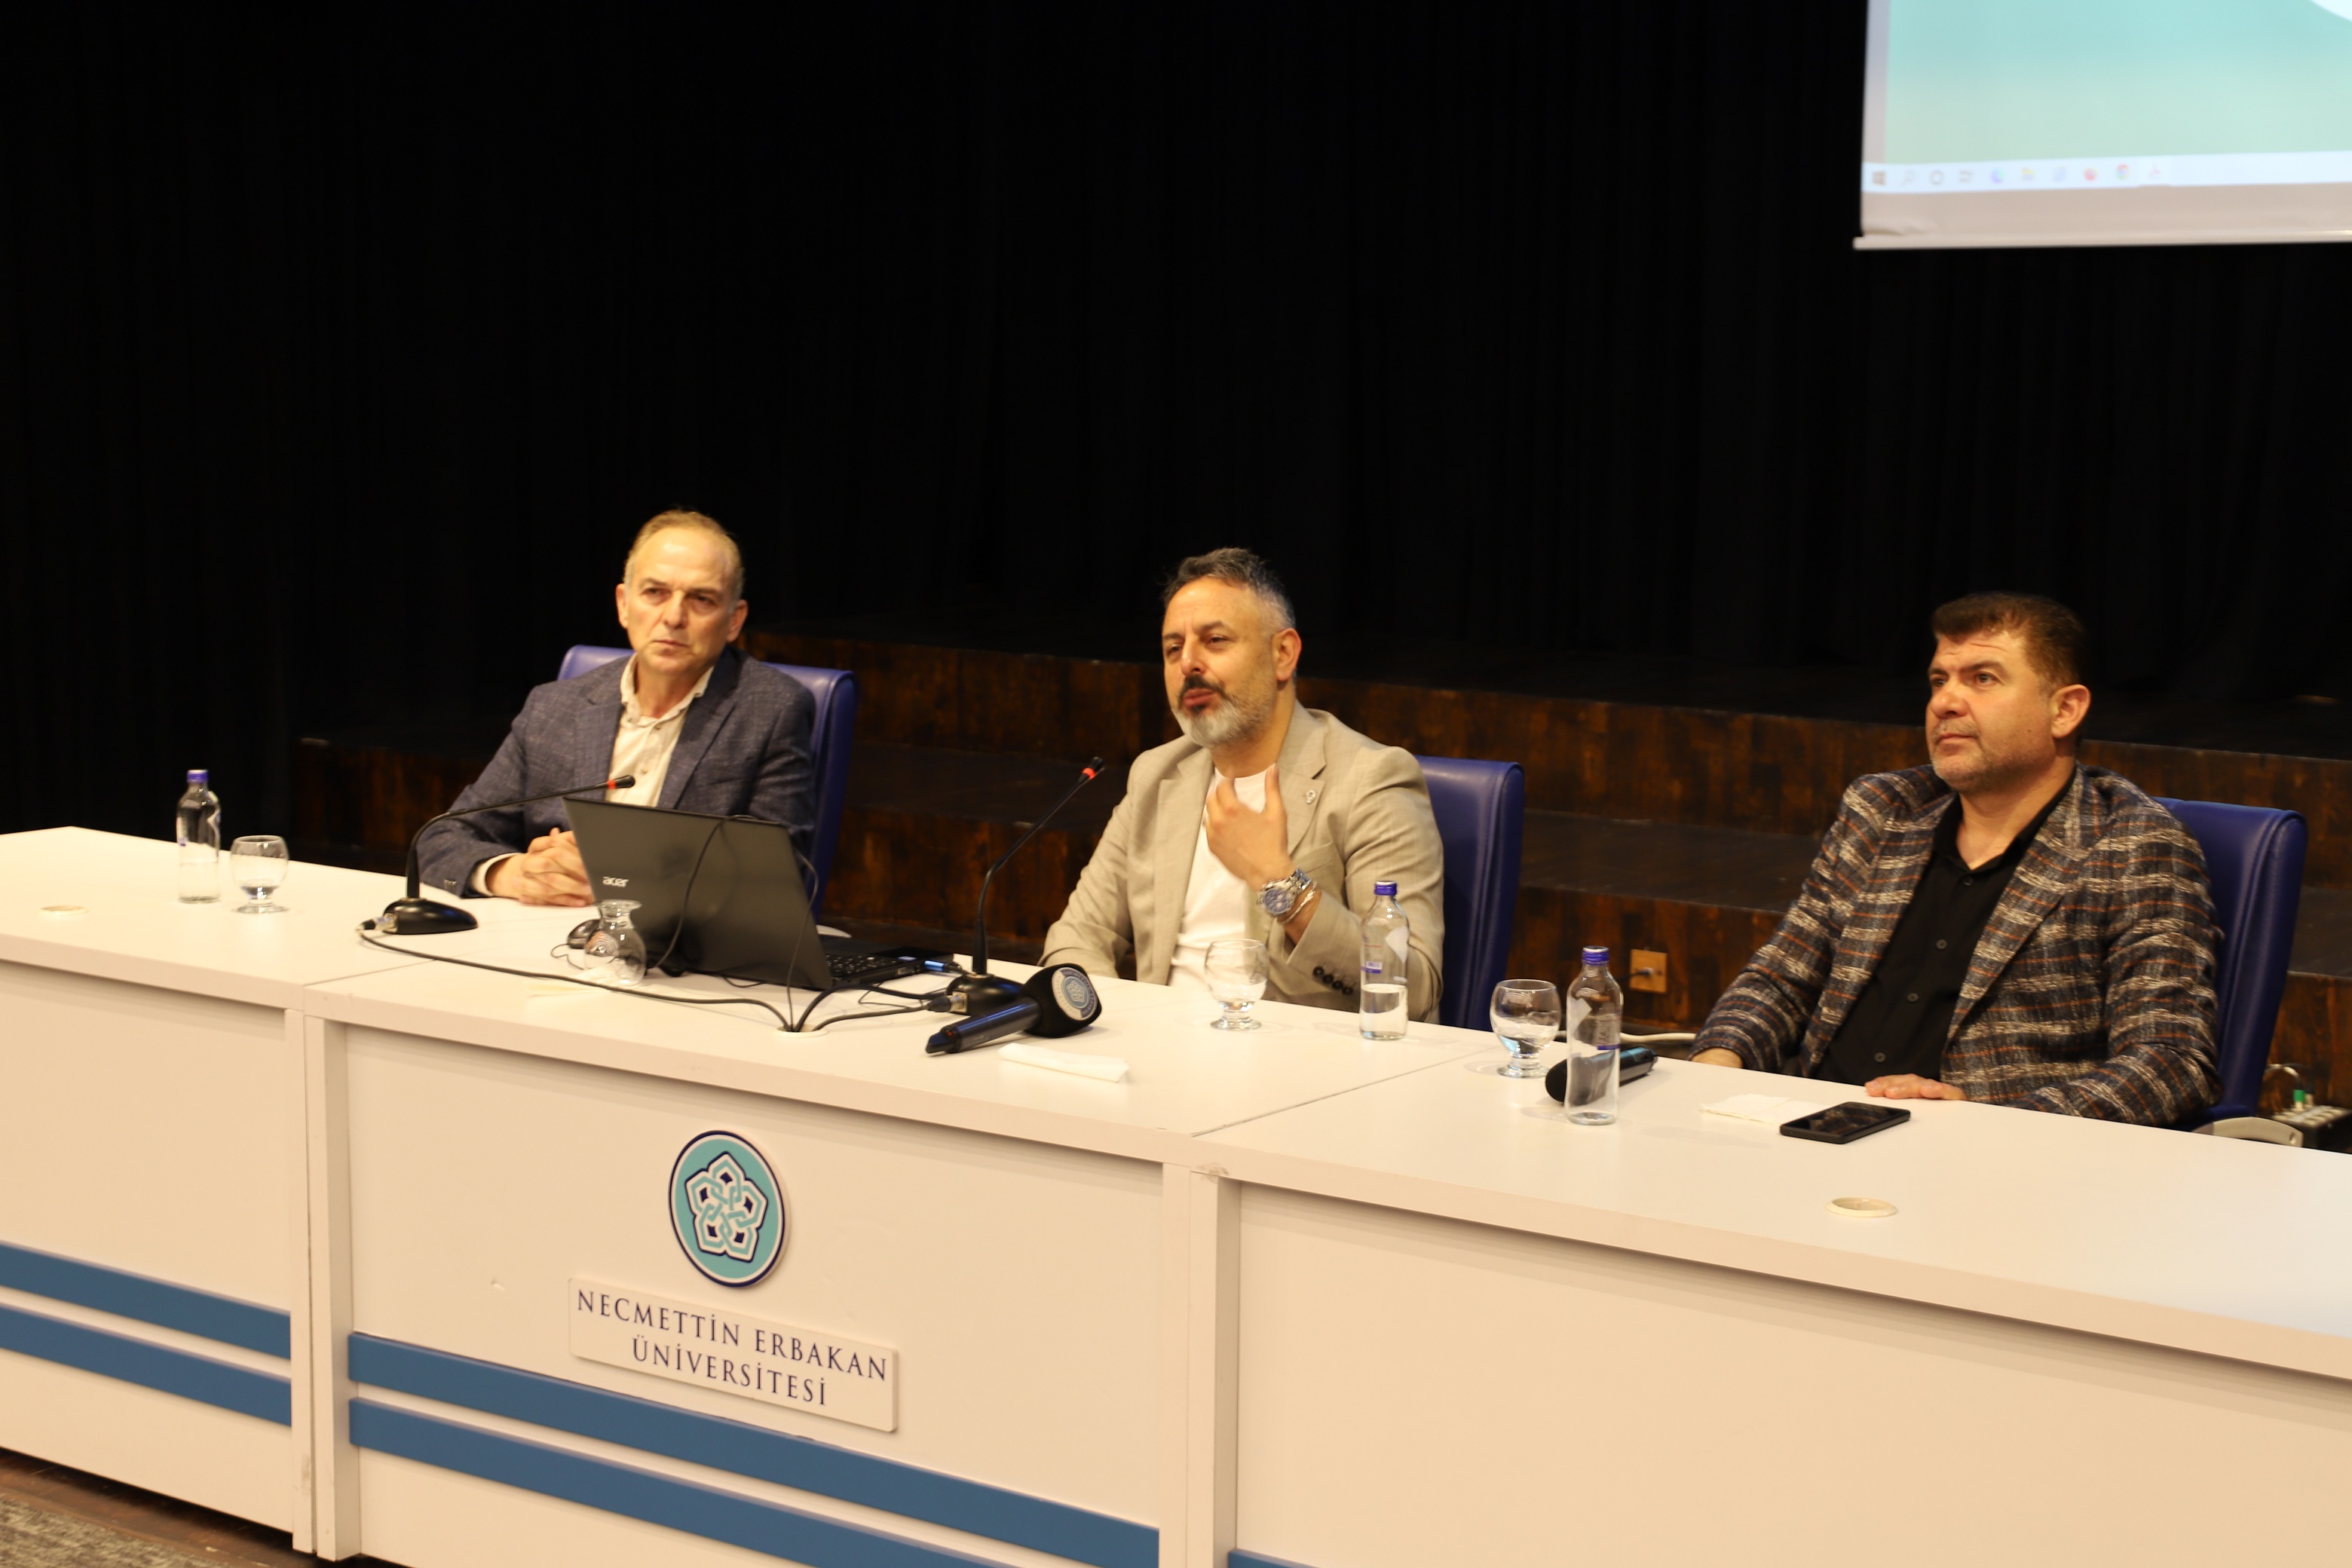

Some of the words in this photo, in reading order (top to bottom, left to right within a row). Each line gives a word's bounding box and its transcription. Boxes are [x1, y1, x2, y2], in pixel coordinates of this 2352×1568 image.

[602, 876, 629, 888] acer
[577, 1289, 740, 1347] NECMETTİN
[755, 1328, 887, 1382] ERBAKAN
[632, 1334, 826, 1406] ÜNİVERSİTESİ
